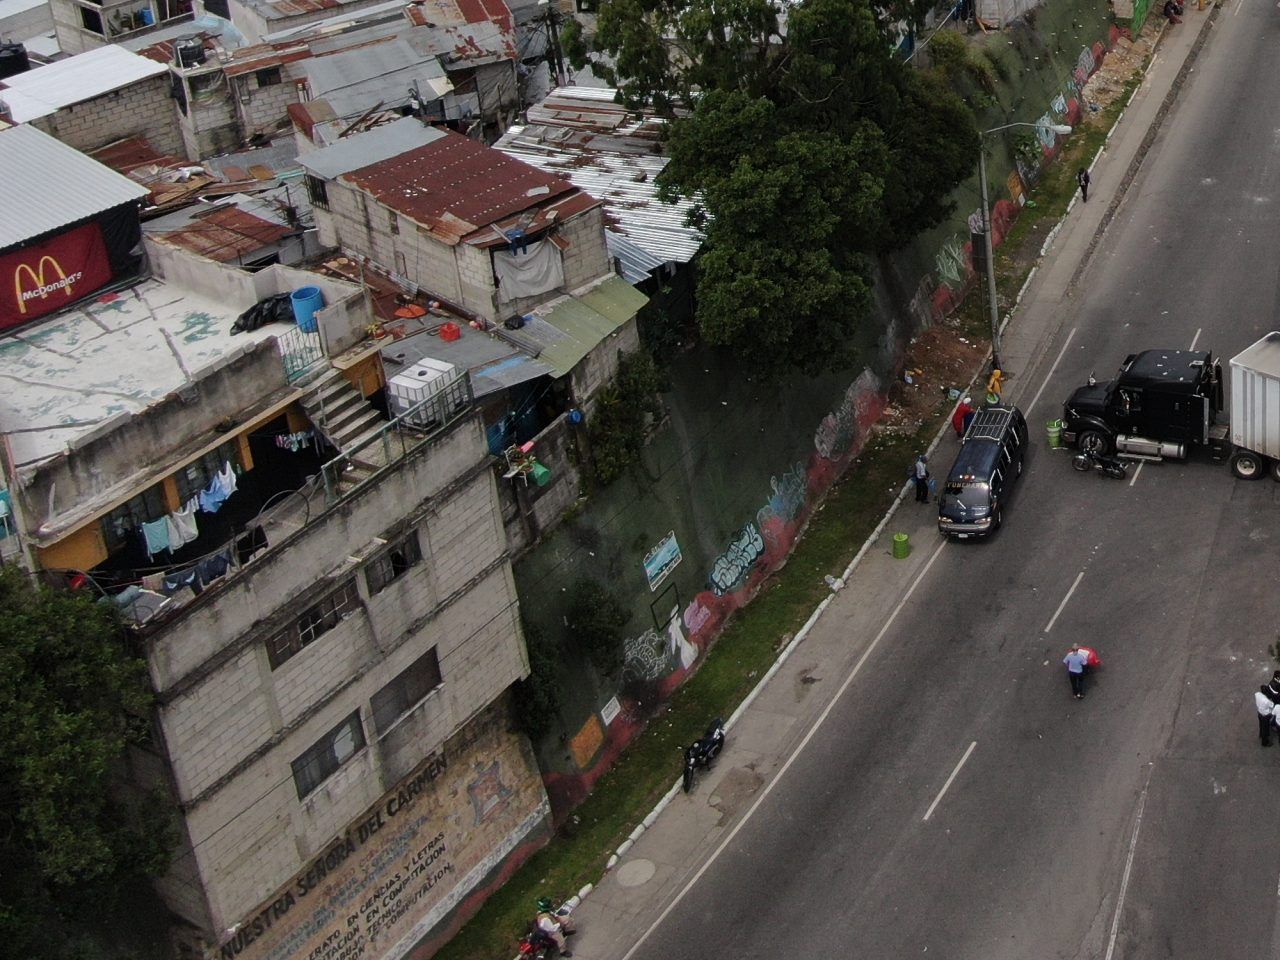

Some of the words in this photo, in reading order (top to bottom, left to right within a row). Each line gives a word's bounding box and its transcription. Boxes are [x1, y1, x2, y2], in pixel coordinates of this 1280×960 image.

[22, 271, 82, 301] McDonald's
[221, 889, 297, 960] NUESTRA
[358, 812, 386, 844] DEL
[386, 754, 448, 817] CARMEN
[359, 872, 401, 914] CIENCIAS
[412, 831, 446, 866] LETRAS
